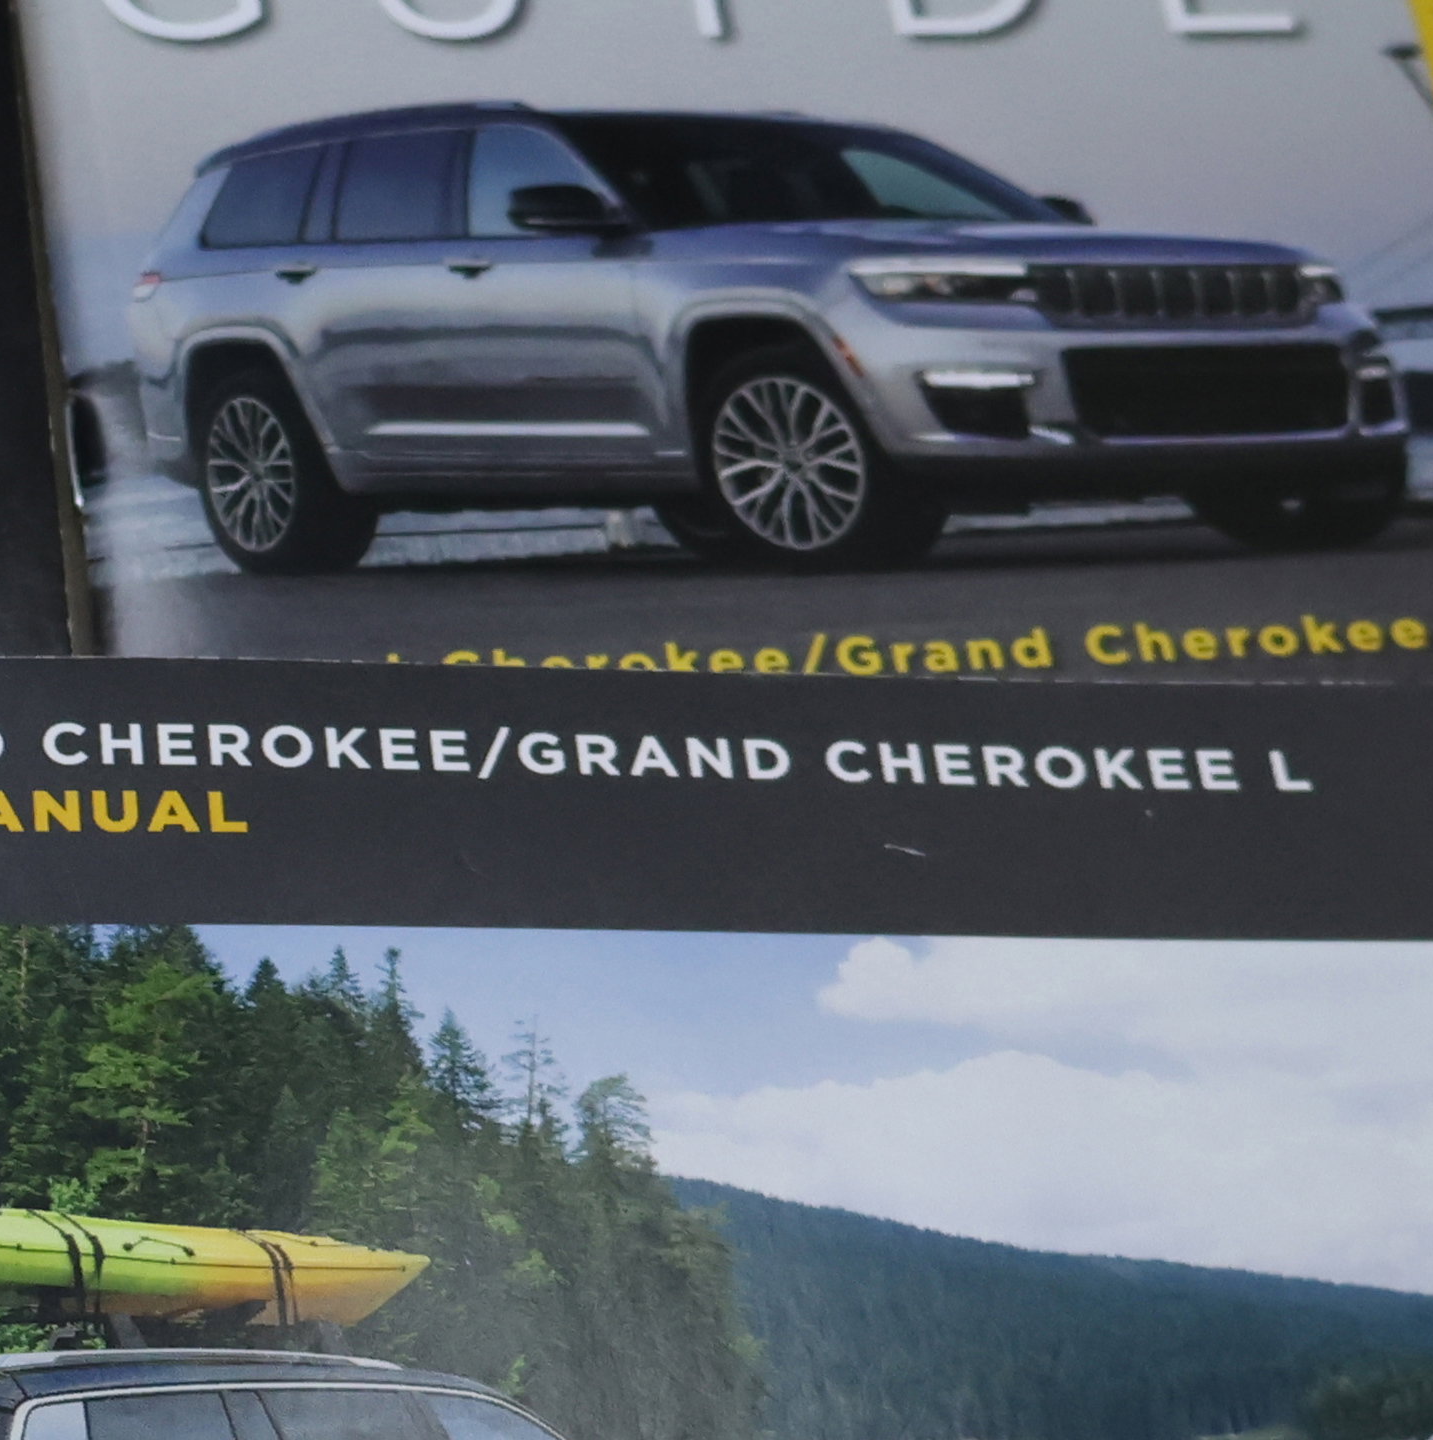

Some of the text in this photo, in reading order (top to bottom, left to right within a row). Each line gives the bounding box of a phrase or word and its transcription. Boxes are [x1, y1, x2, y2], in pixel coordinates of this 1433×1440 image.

[1084, 614, 1429, 666] Cherokee
[42, 722, 793, 782] CHEROKEE/GRAND
[825, 740, 1240, 792] CHEROKEE
[1271, 749, 1315, 793] L
